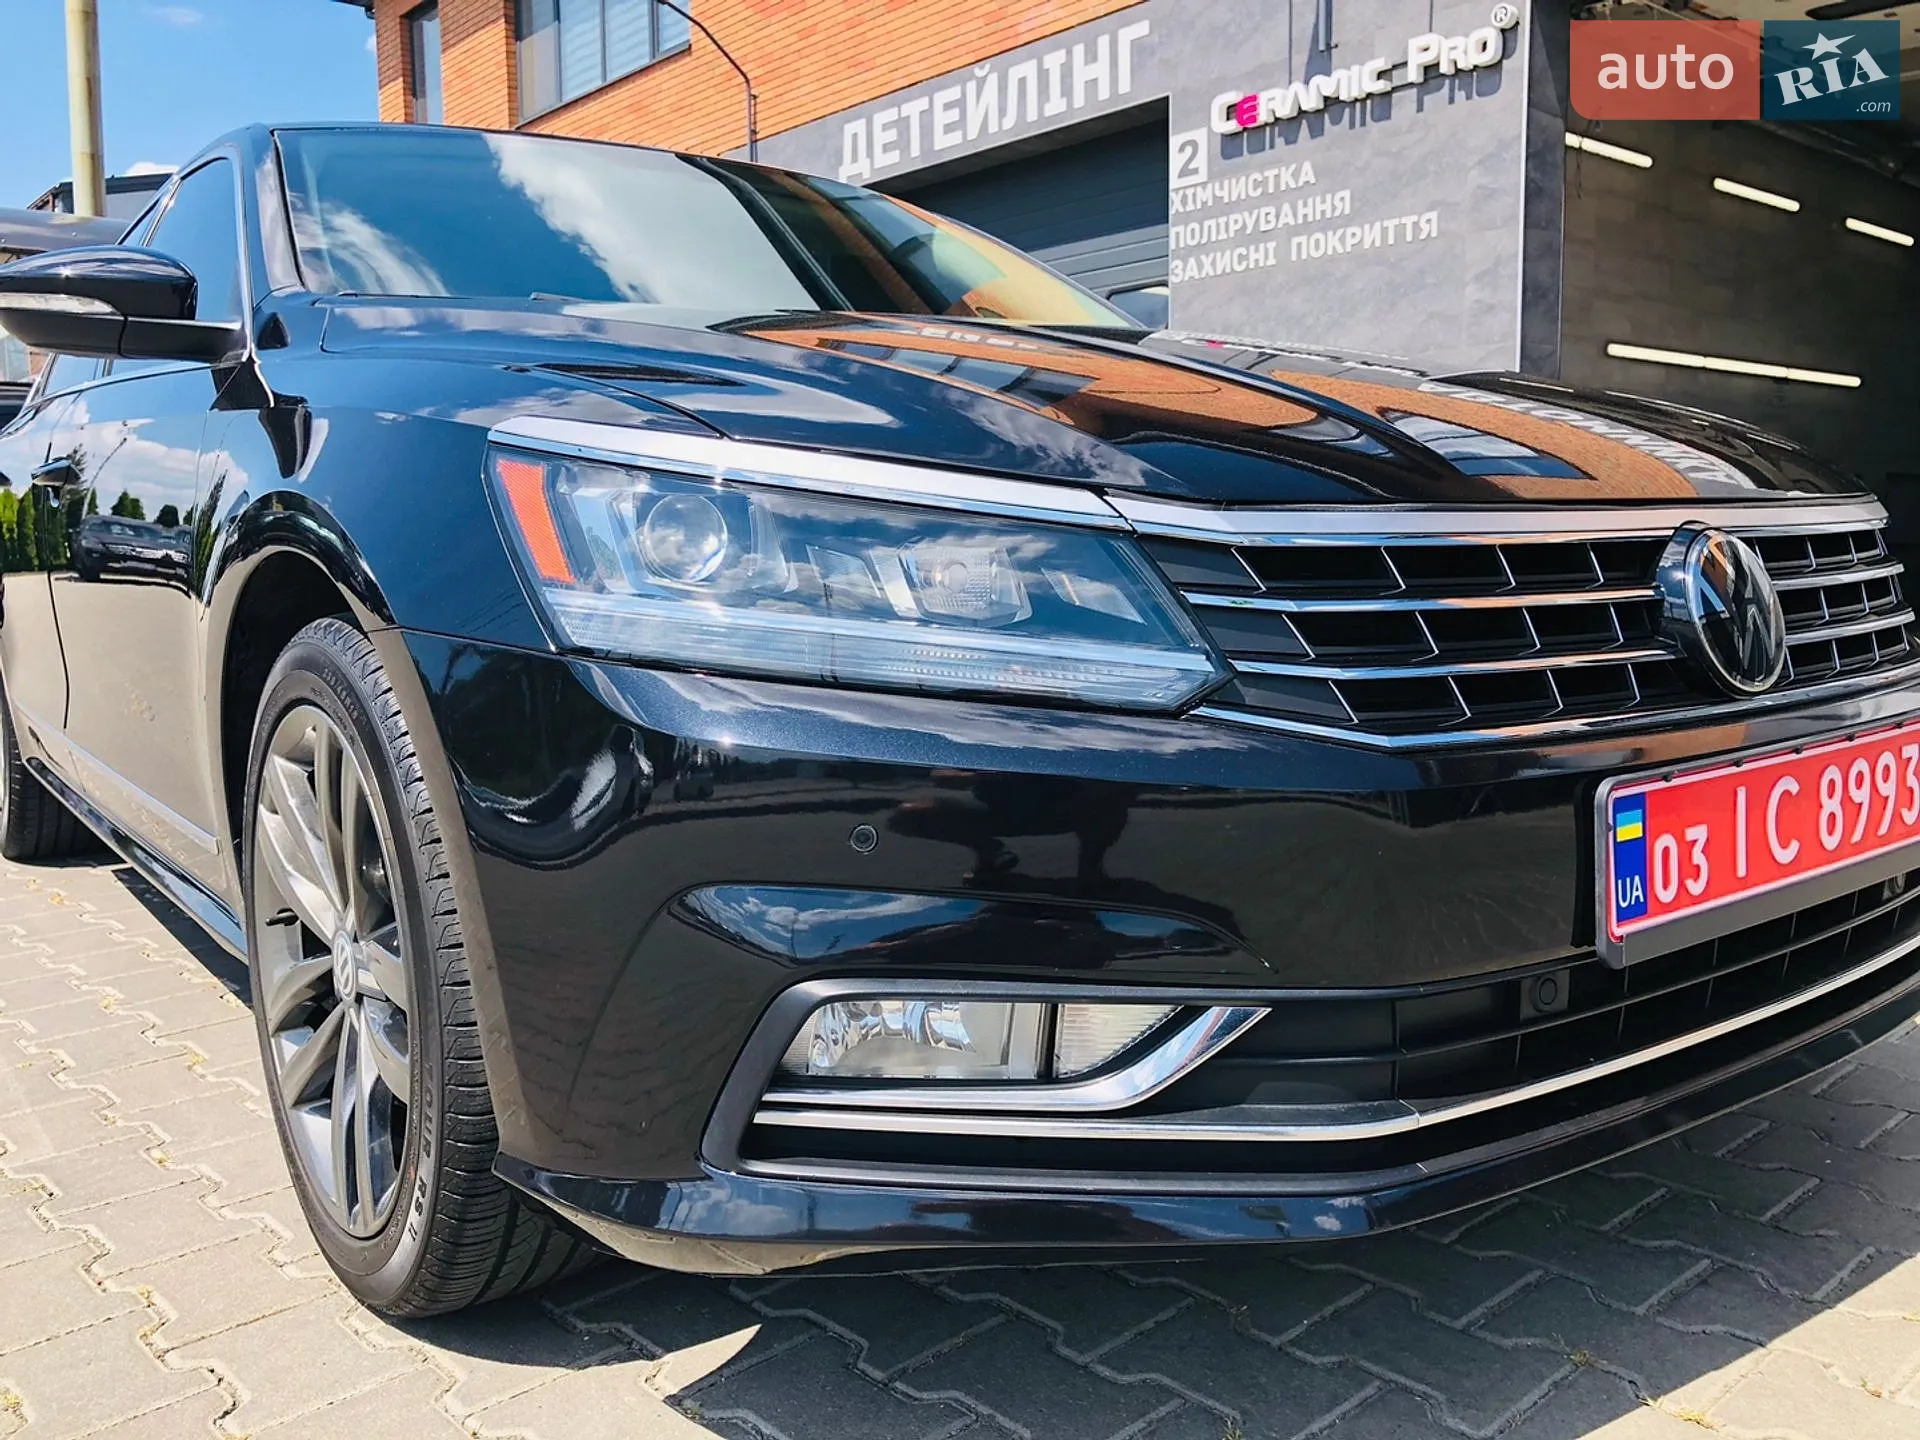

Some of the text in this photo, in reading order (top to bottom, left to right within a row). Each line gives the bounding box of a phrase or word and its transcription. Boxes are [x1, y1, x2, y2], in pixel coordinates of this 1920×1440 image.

[838, 20, 1150, 184] ДЕТЕЙЛІНГ
[1171, 161, 1316, 215] ХІМЧИСТКА
[1177, 138, 1201, 179] 2
[1171, 189, 1352, 250] ПОЛІРУВАННЯ
[1171, 211, 1440, 284] ЗАХИСНІ ПОКРИТТЯ
[1653, 823, 1710, 904] 03
[1818, 742, 1920, 852] 8993
[1617, 874, 1645, 908] UA
